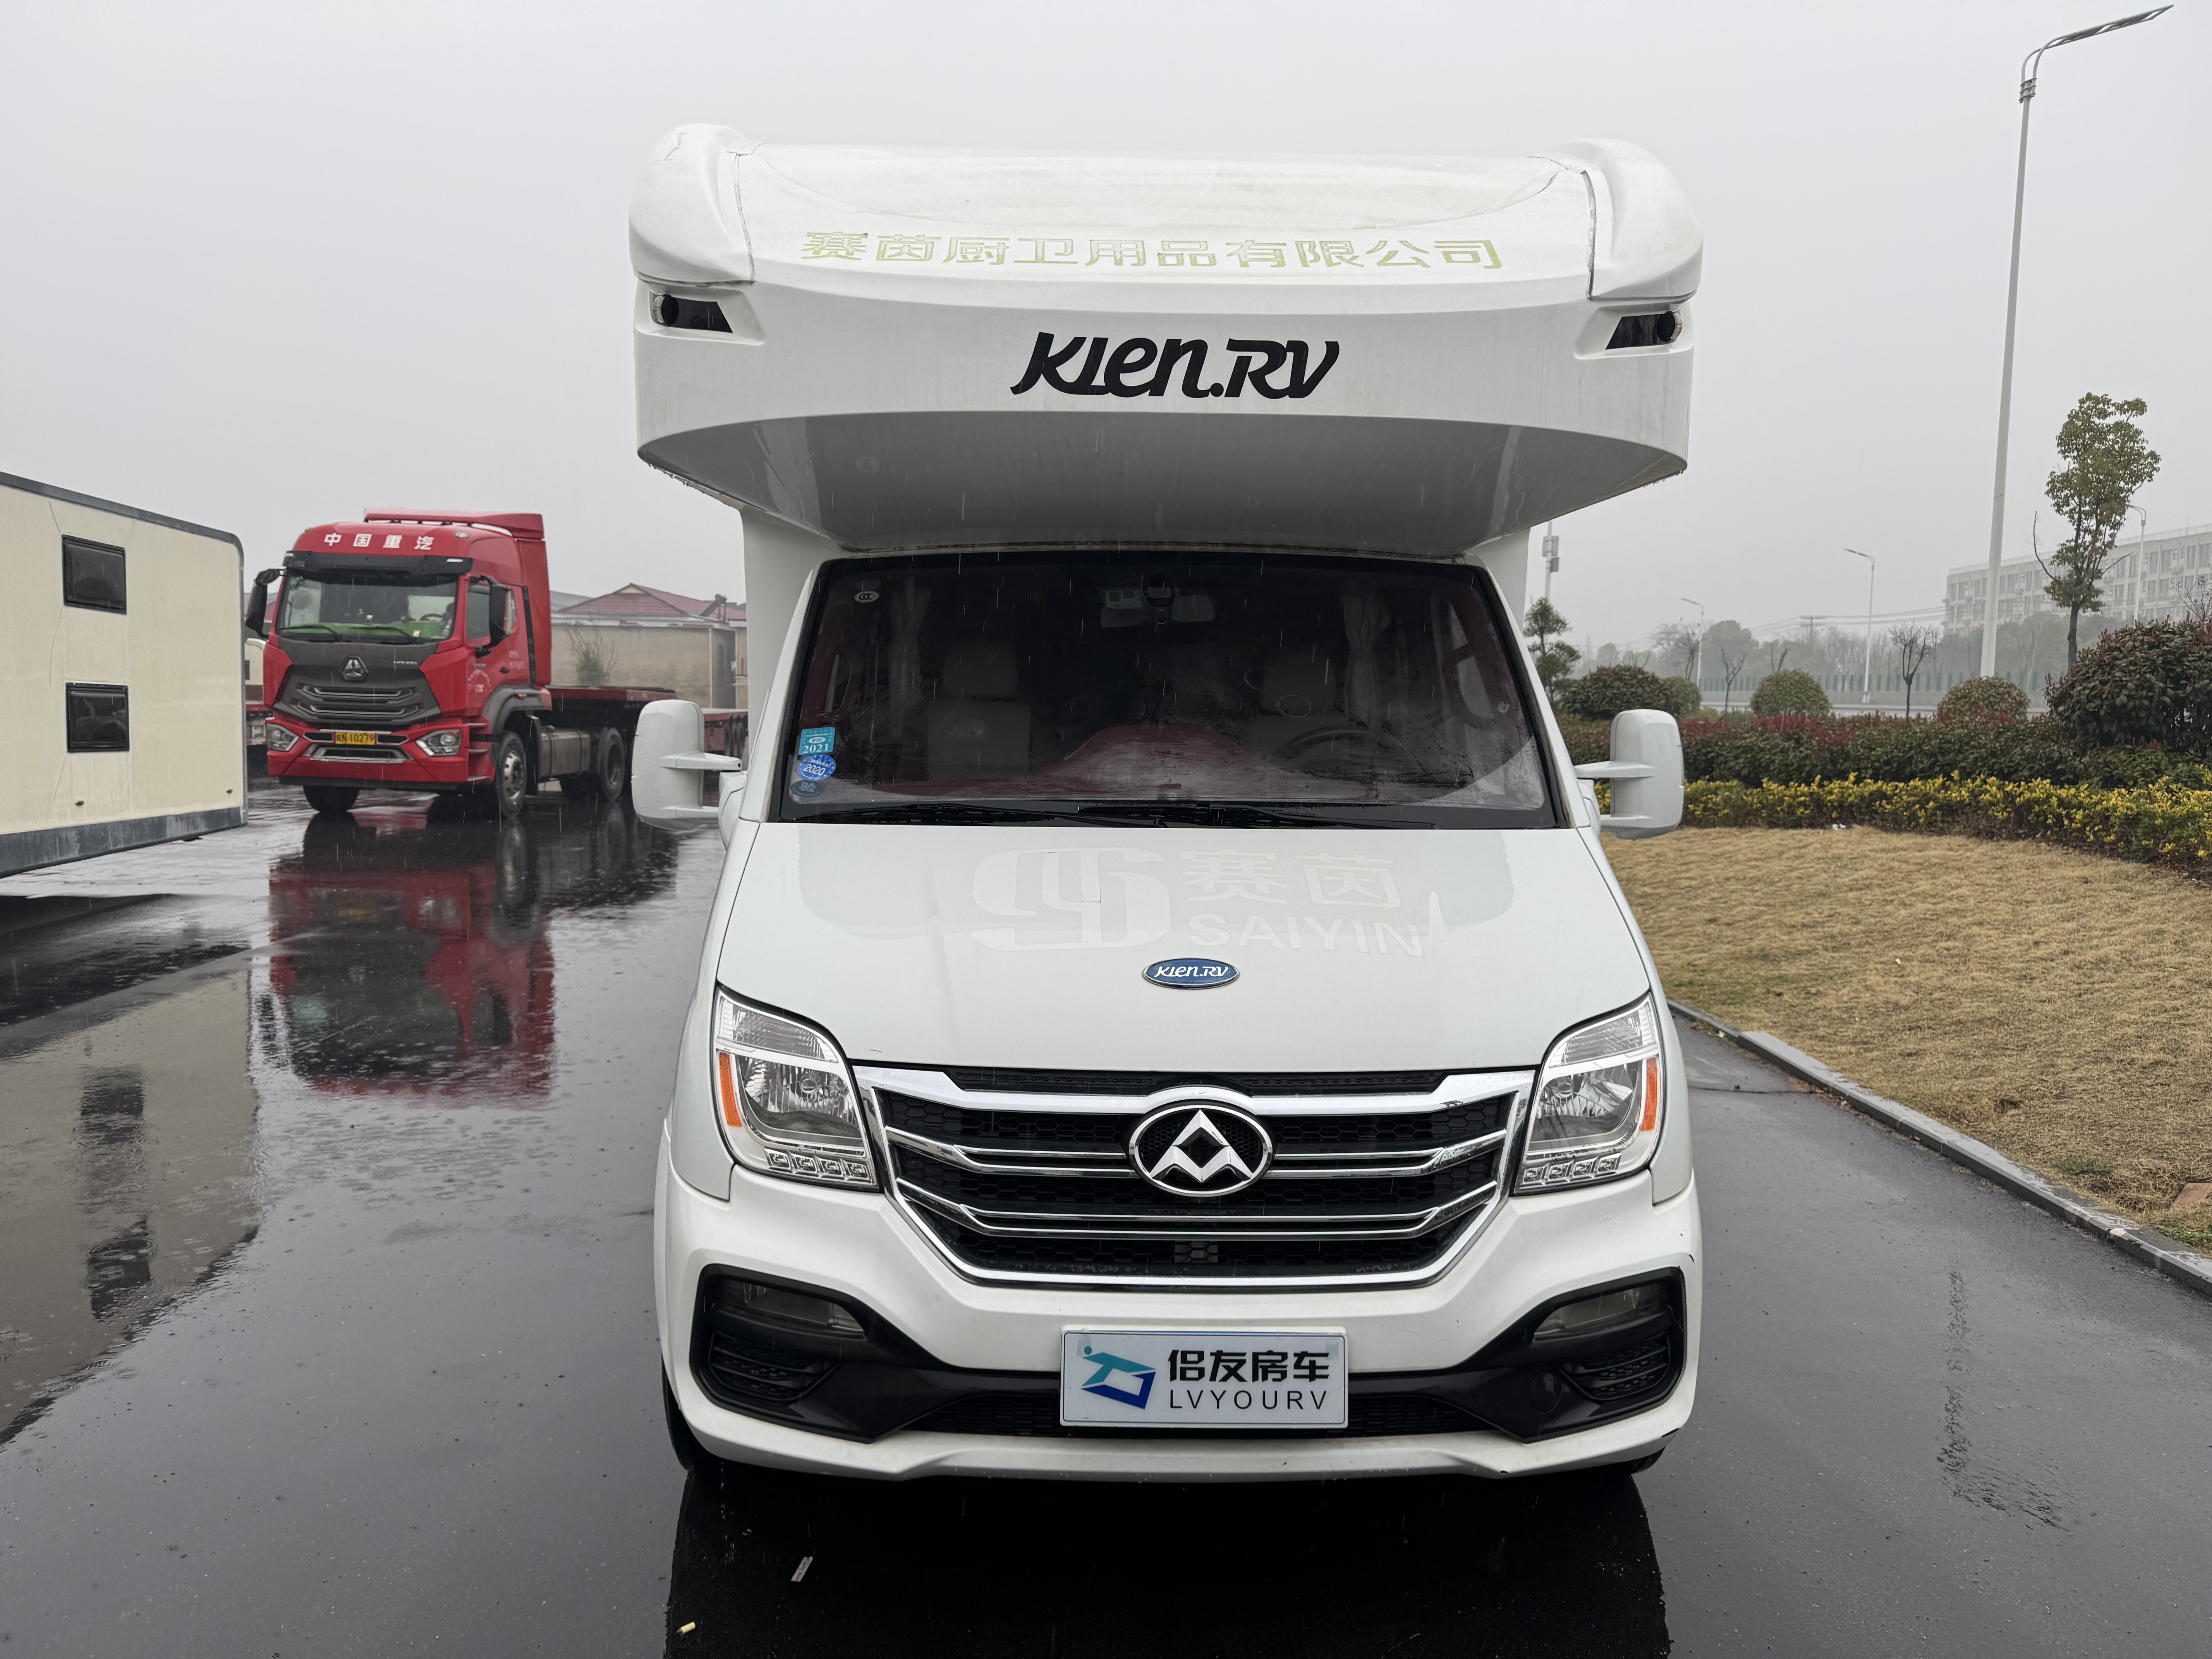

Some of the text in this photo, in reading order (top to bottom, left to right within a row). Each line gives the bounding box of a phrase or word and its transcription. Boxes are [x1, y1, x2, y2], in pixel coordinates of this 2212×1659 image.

[801, 231, 1503, 269] 赛茵厨卫用品有限公司
[324, 533, 434, 550] 中国重汽
[802, 744, 829, 754] 2021
[803, 764, 826, 776] 2020
[1180, 849, 1401, 908] 赛茵
[1189, 914, 1424, 958] SAIYIN
[1168, 1349, 1329, 1382] 侣友房车
[1170, 1389, 1327, 1410] LVYOURV
